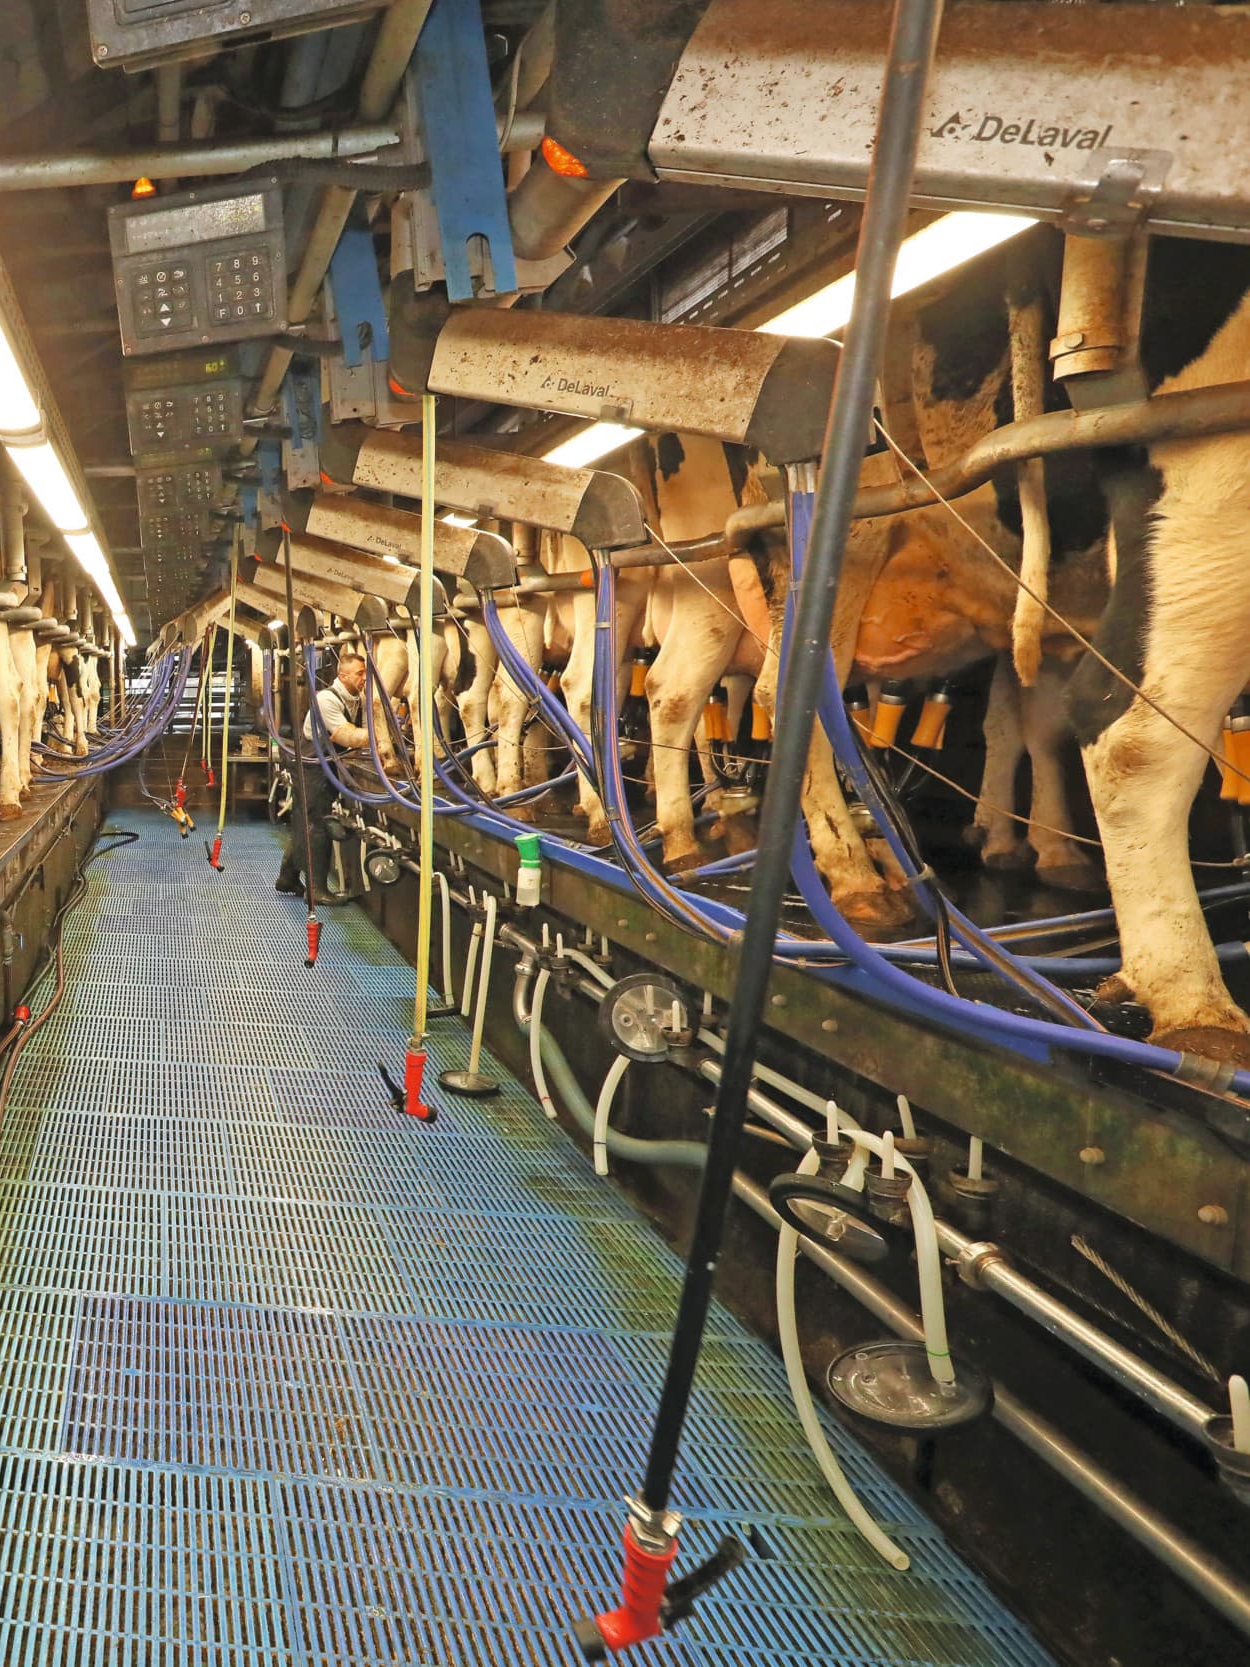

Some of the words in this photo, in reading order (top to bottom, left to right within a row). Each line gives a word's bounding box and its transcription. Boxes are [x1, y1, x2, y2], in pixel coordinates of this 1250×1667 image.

[974, 115, 1114, 150] DeLaval
[215, 262, 222, 272] 7
[233, 259, 240, 269] 8
[252, 256, 259, 266] 9
[215, 278, 222, 288] 4
[234, 275, 241, 285] 5
[252, 272, 260, 282] 6
[236, 290, 243, 300] 2
[253, 287, 260, 297] 3
[219, 308, 226, 318] F
[237, 306, 244, 315] 0
[557, 377, 610, 397] DeLaval
[375, 537, 402, 549] DeLaval
